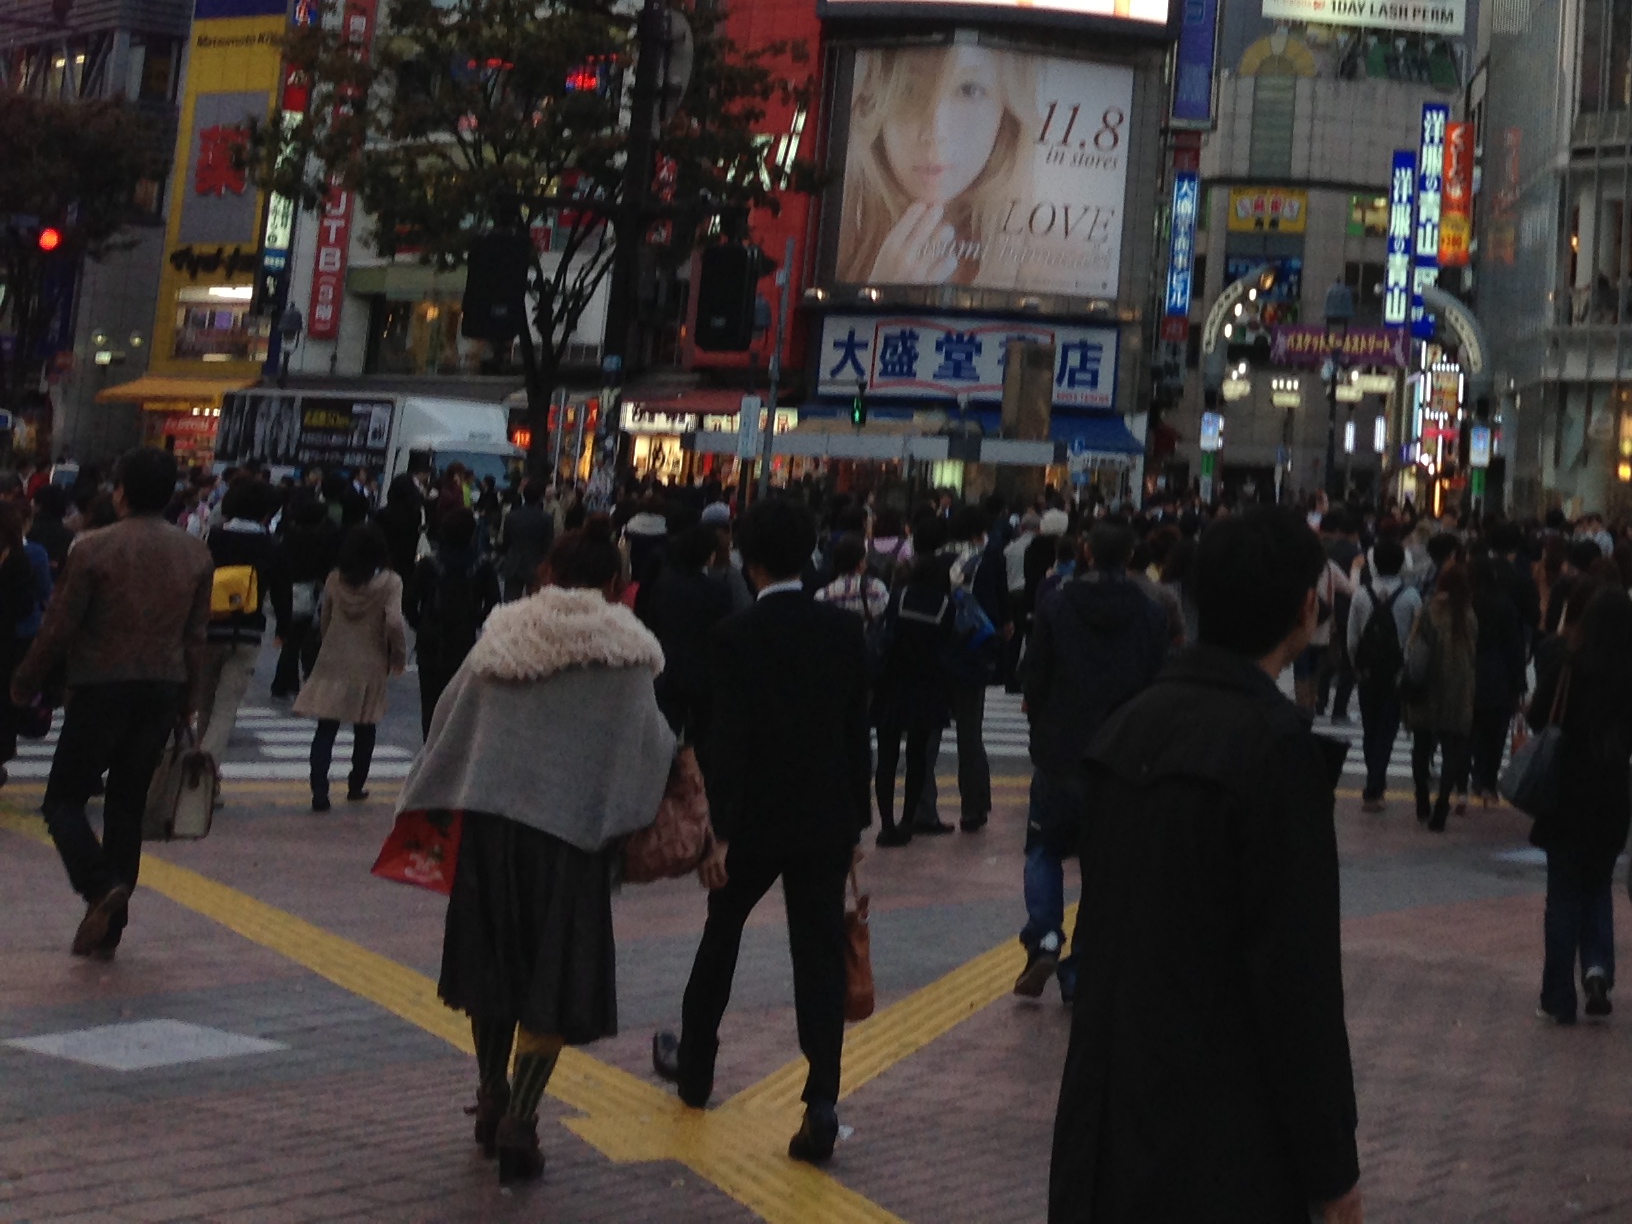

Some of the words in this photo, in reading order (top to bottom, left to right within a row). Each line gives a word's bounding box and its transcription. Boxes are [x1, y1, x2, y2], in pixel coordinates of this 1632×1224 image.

[1369, 0, 1409, 21] LASH
[1036, 99, 1125, 153] 11.8
[1046, 146, 1064, 163] in
[1068, 149, 1119, 172] stores
[318, 190, 348, 273] JTB
[1000, 199, 1115, 245] LOVE
[828, 324, 1104, 390] 大盛堂店
